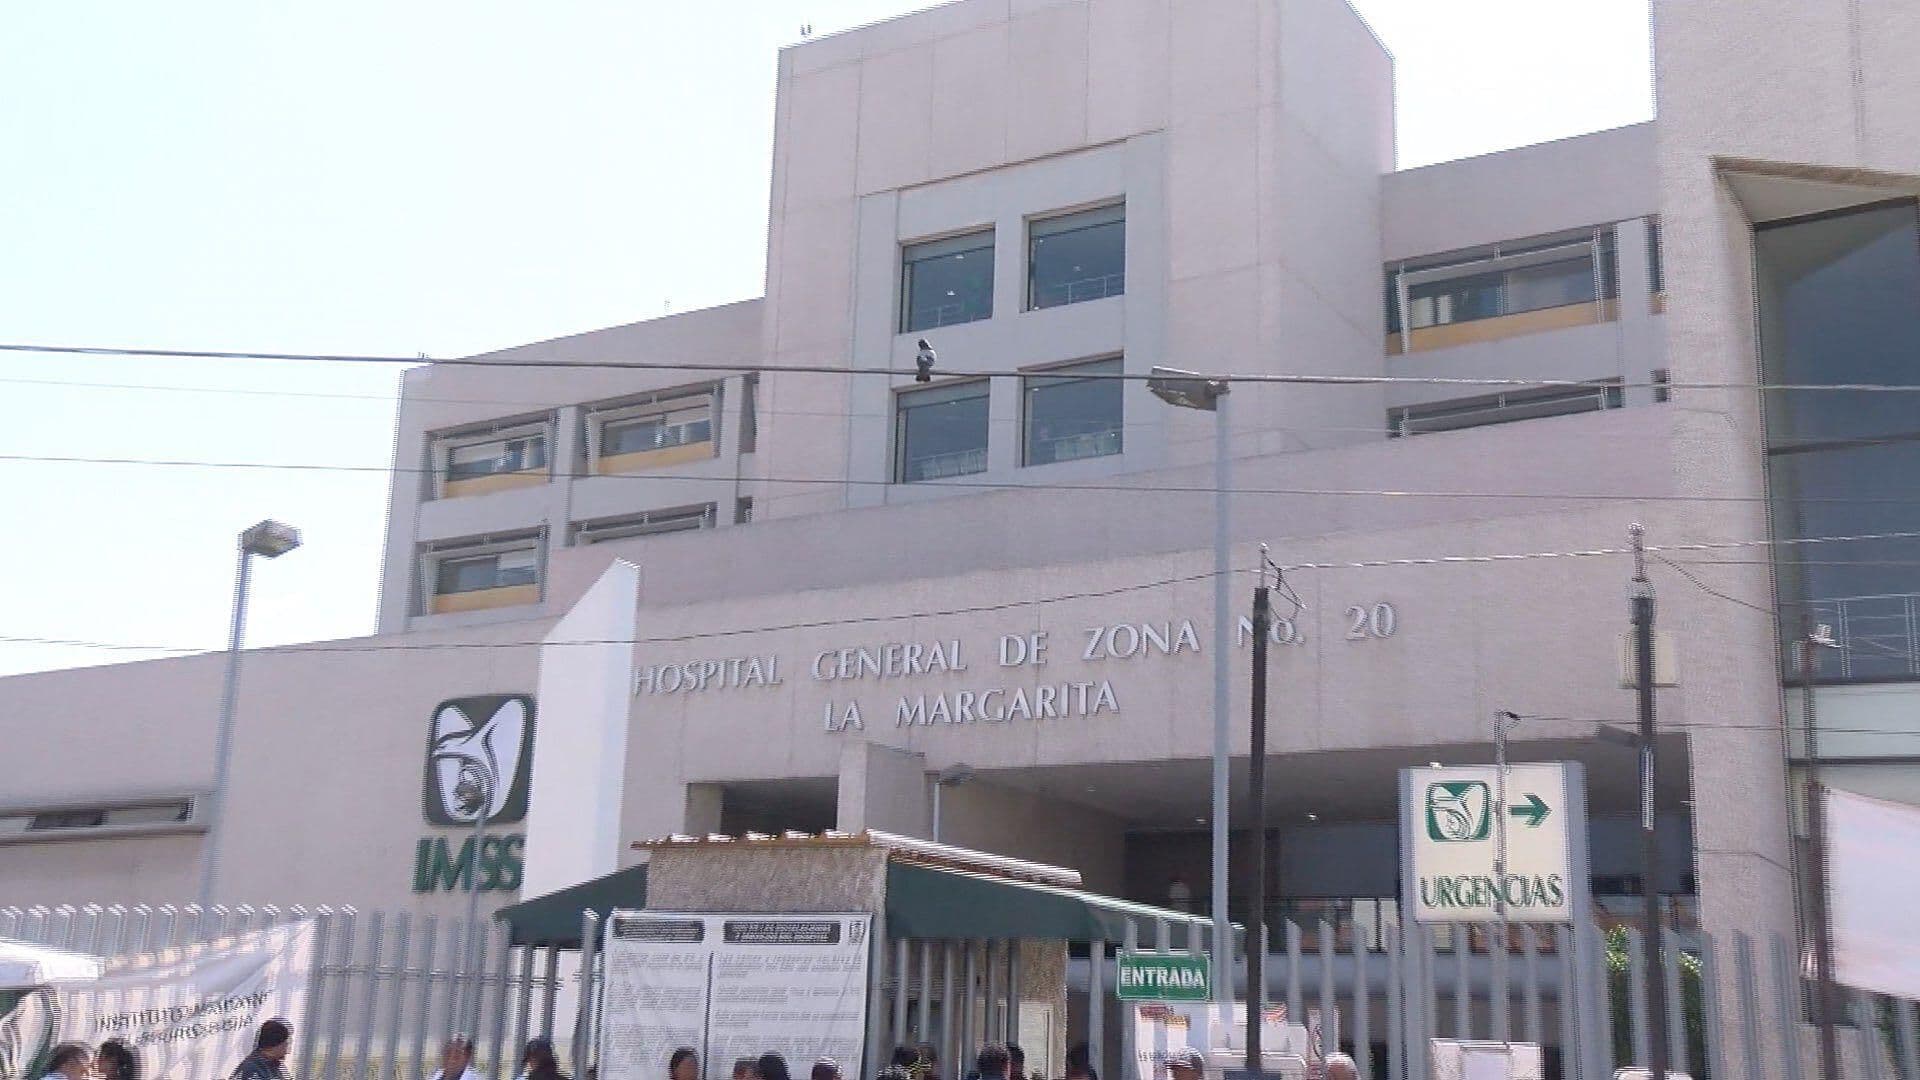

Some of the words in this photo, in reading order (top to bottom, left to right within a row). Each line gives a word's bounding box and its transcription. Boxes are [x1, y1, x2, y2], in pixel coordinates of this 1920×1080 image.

[633, 654, 784, 696] HOSPITAL
[812, 639, 968, 681] GENERAL
[999, 631, 1049, 667] DE
[1082, 620, 1200, 661] ZONA
[1345, 602, 1397, 641] 20
[823, 699, 865, 732] LA
[896, 680, 1120, 728] MARGARITA
[413, 834, 526, 892] IMSS
[1420, 873, 1563, 908] URGENCIAS
[1120, 967, 1205, 988] ENTRADA
